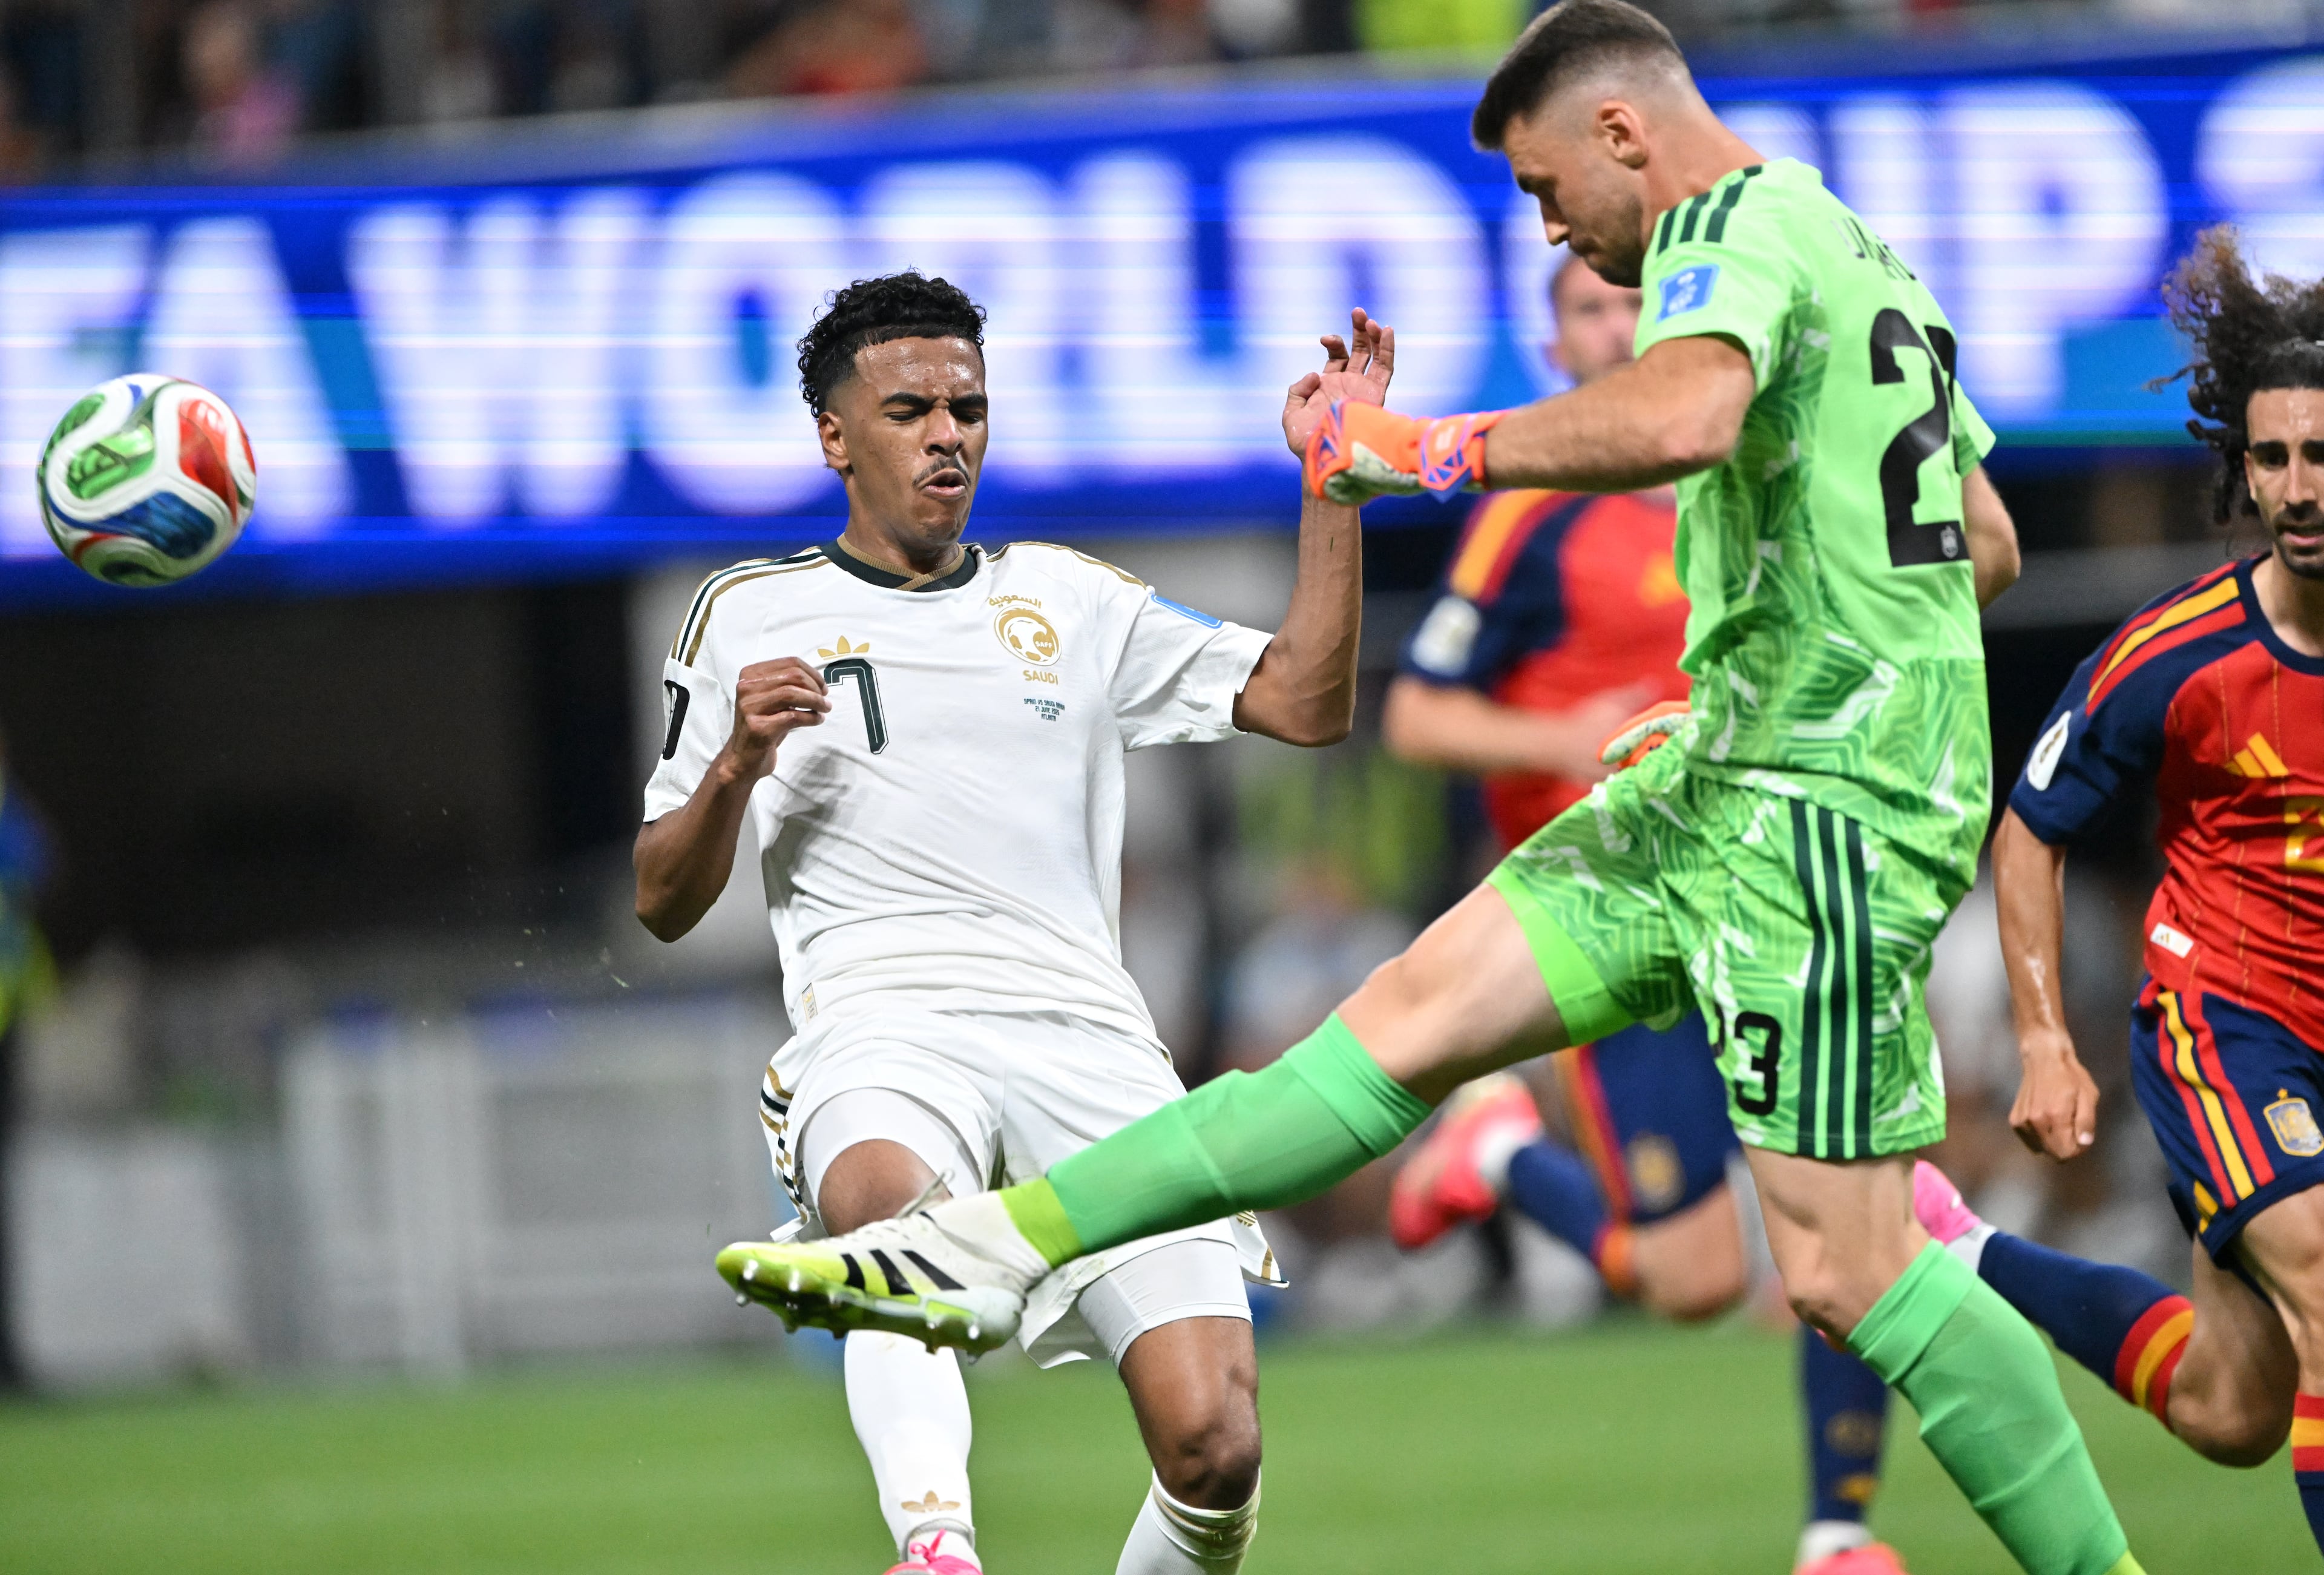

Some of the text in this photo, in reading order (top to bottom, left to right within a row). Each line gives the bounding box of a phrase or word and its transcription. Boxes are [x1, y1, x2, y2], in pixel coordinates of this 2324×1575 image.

[343, 134, 1484, 530] WORLD
[1023, 669, 1059, 685] SAUDI
[824, 659, 889, 755] 7
[1041, 713, 1057, 722] ATLANTA
